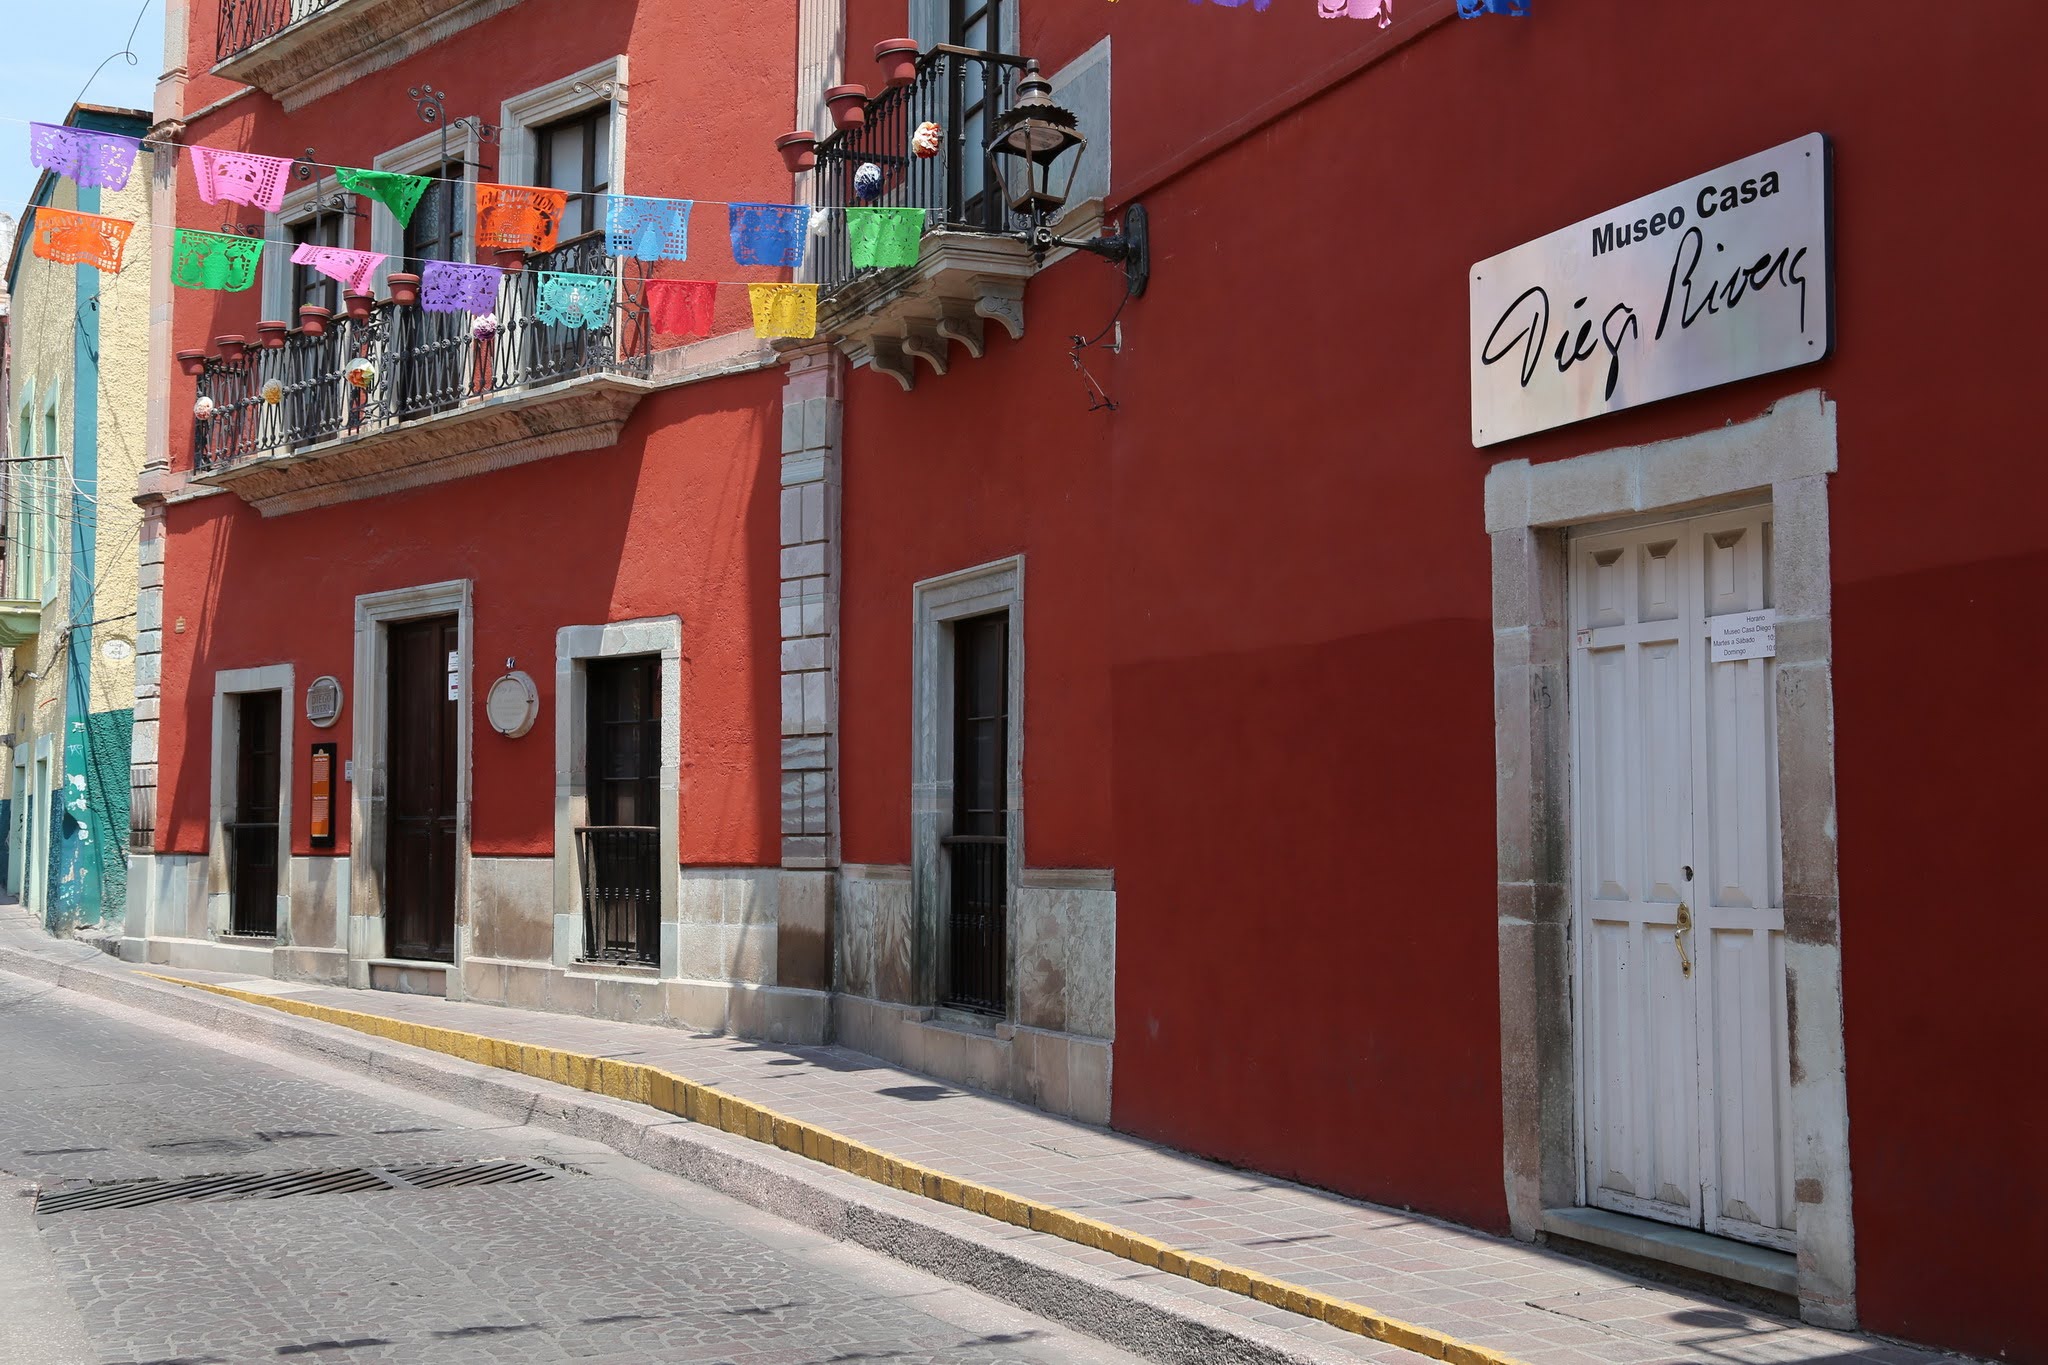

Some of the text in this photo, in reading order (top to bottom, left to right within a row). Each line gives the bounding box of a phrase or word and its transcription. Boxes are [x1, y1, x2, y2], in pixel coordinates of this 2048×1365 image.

[1592, 170, 1780, 257] Museo Casa
[1655, 226, 1807, 341] Rivera
[311, 694, 331, 706] DIEGO
[311, 704, 331, 714] RIVERA
